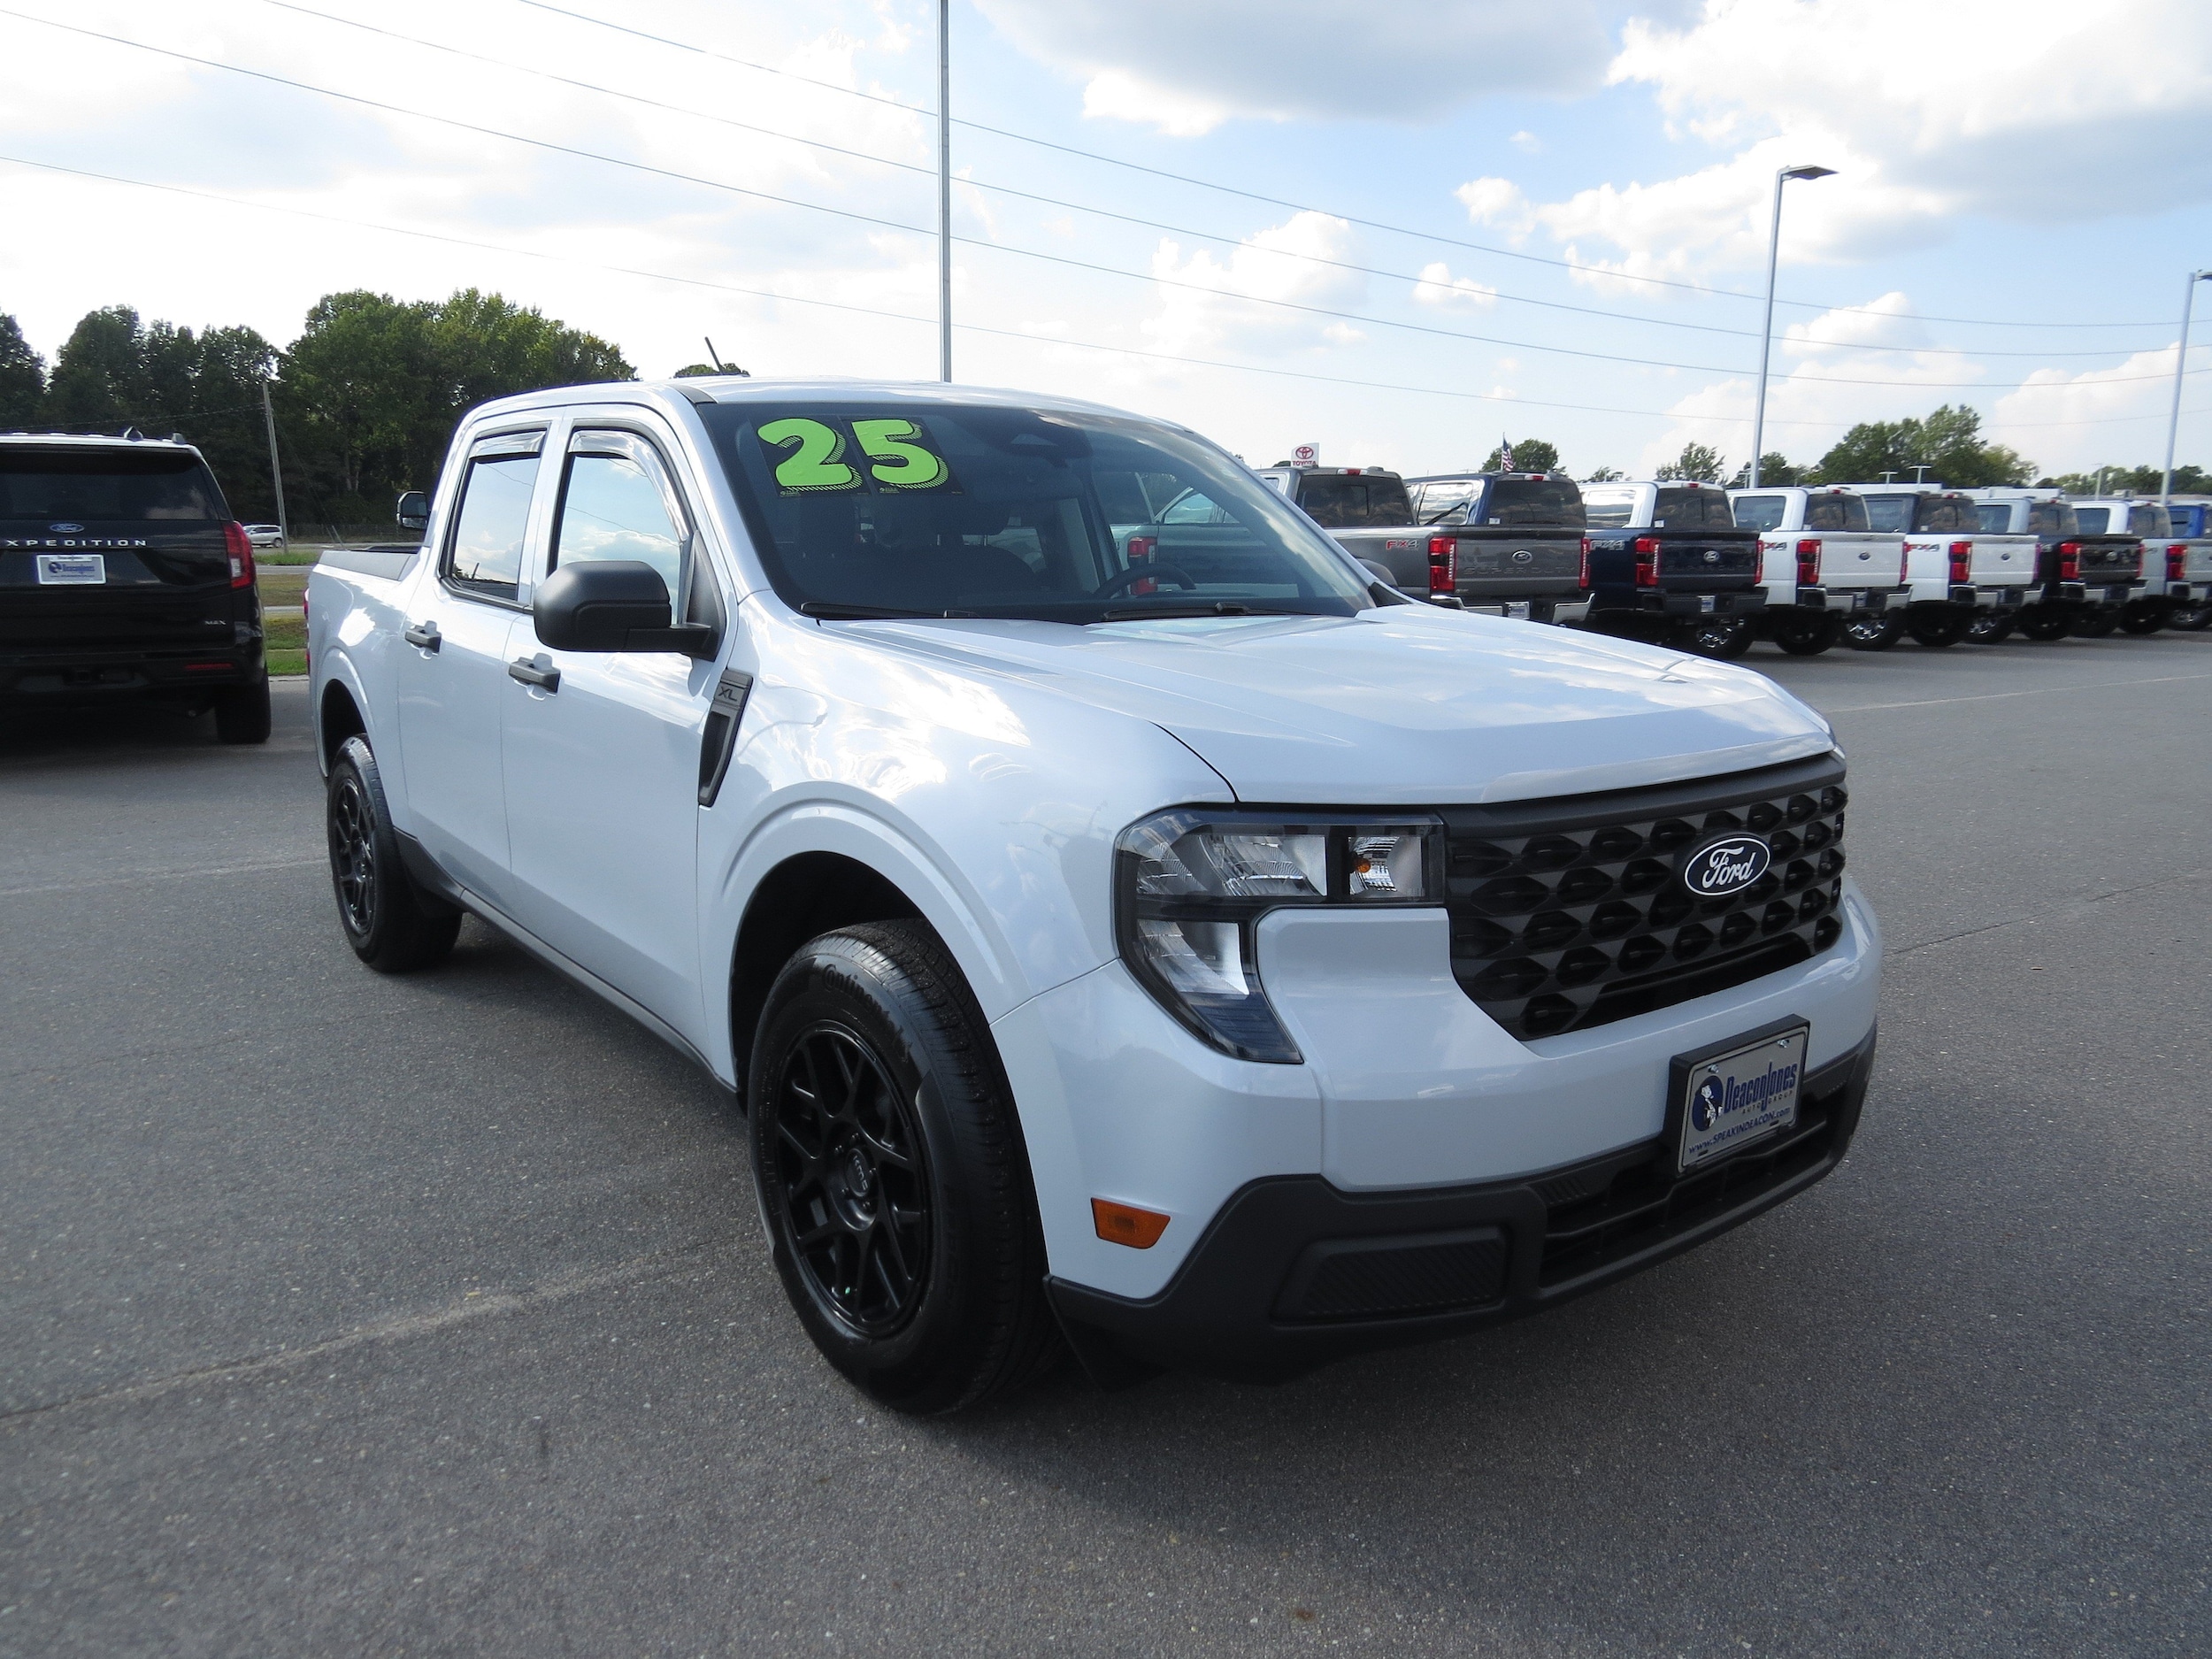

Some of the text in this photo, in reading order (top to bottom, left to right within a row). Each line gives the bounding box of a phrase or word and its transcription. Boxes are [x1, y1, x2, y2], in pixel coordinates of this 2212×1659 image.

[757, 418, 949, 490] 25
[1386, 540, 1418, 550] FX4
[1702, 847, 1756, 888] Ford
